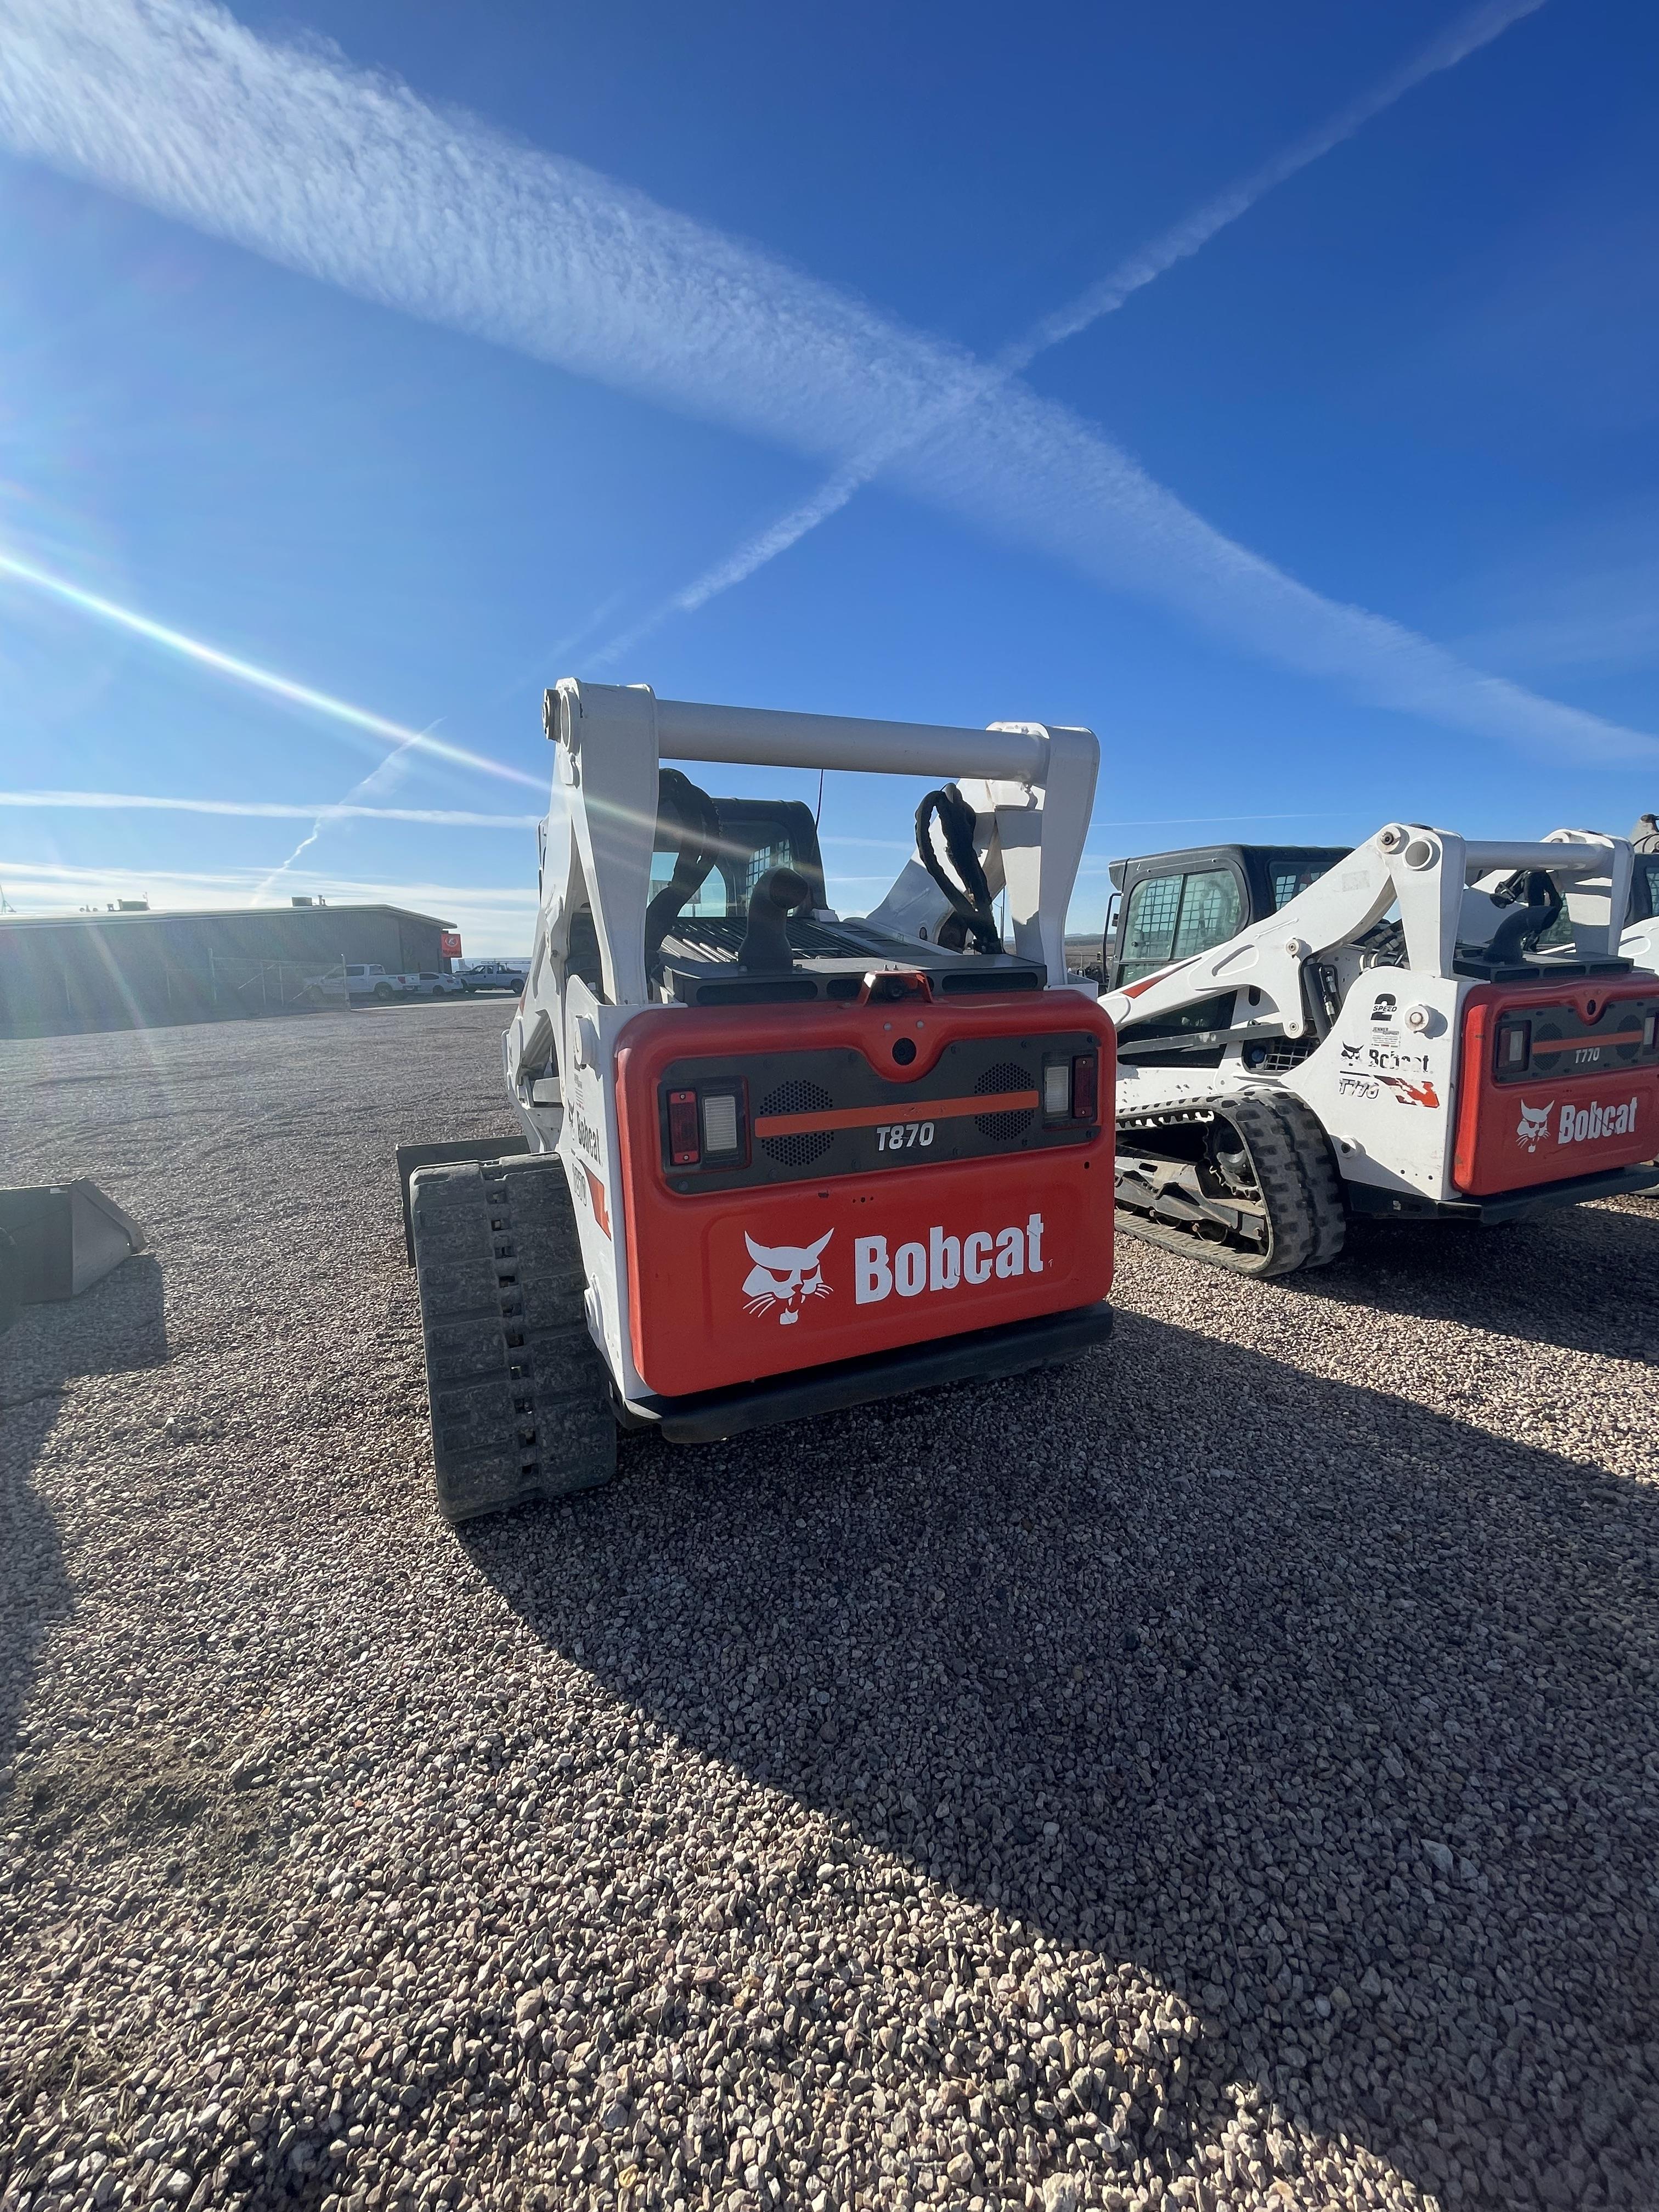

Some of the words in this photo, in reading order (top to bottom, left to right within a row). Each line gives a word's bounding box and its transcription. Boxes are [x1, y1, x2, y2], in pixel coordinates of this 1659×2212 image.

[1370, 994, 1396, 1021] 2
[1368, 1049, 1429, 1073] Bobt
[1575, 1047, 1600, 1064] T770
[1558, 1097, 1638, 1144] Bobcat
[876, 1122, 935, 1151] T870
[855, 1213, 1044, 1305] Bobcat
